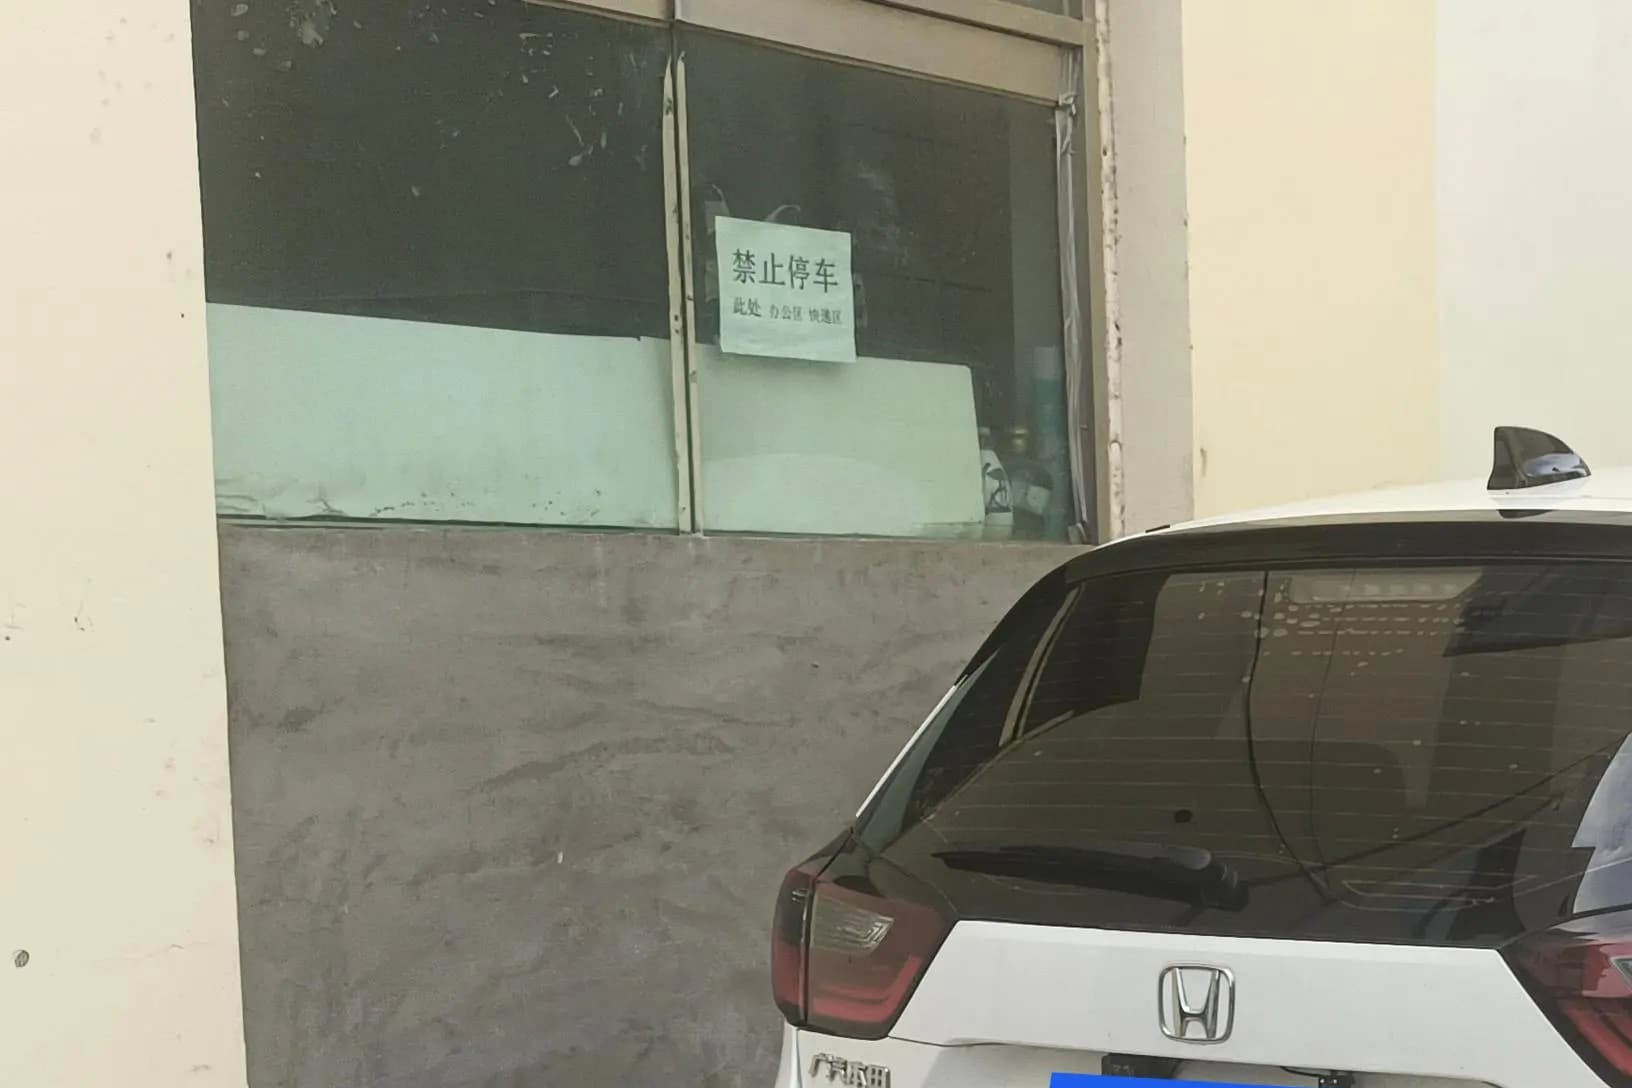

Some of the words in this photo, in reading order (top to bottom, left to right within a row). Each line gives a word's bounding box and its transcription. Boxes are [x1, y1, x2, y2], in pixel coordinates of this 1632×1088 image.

[732, 249, 838, 293] 禁止停车
[733, 297, 762, 318] 此处
